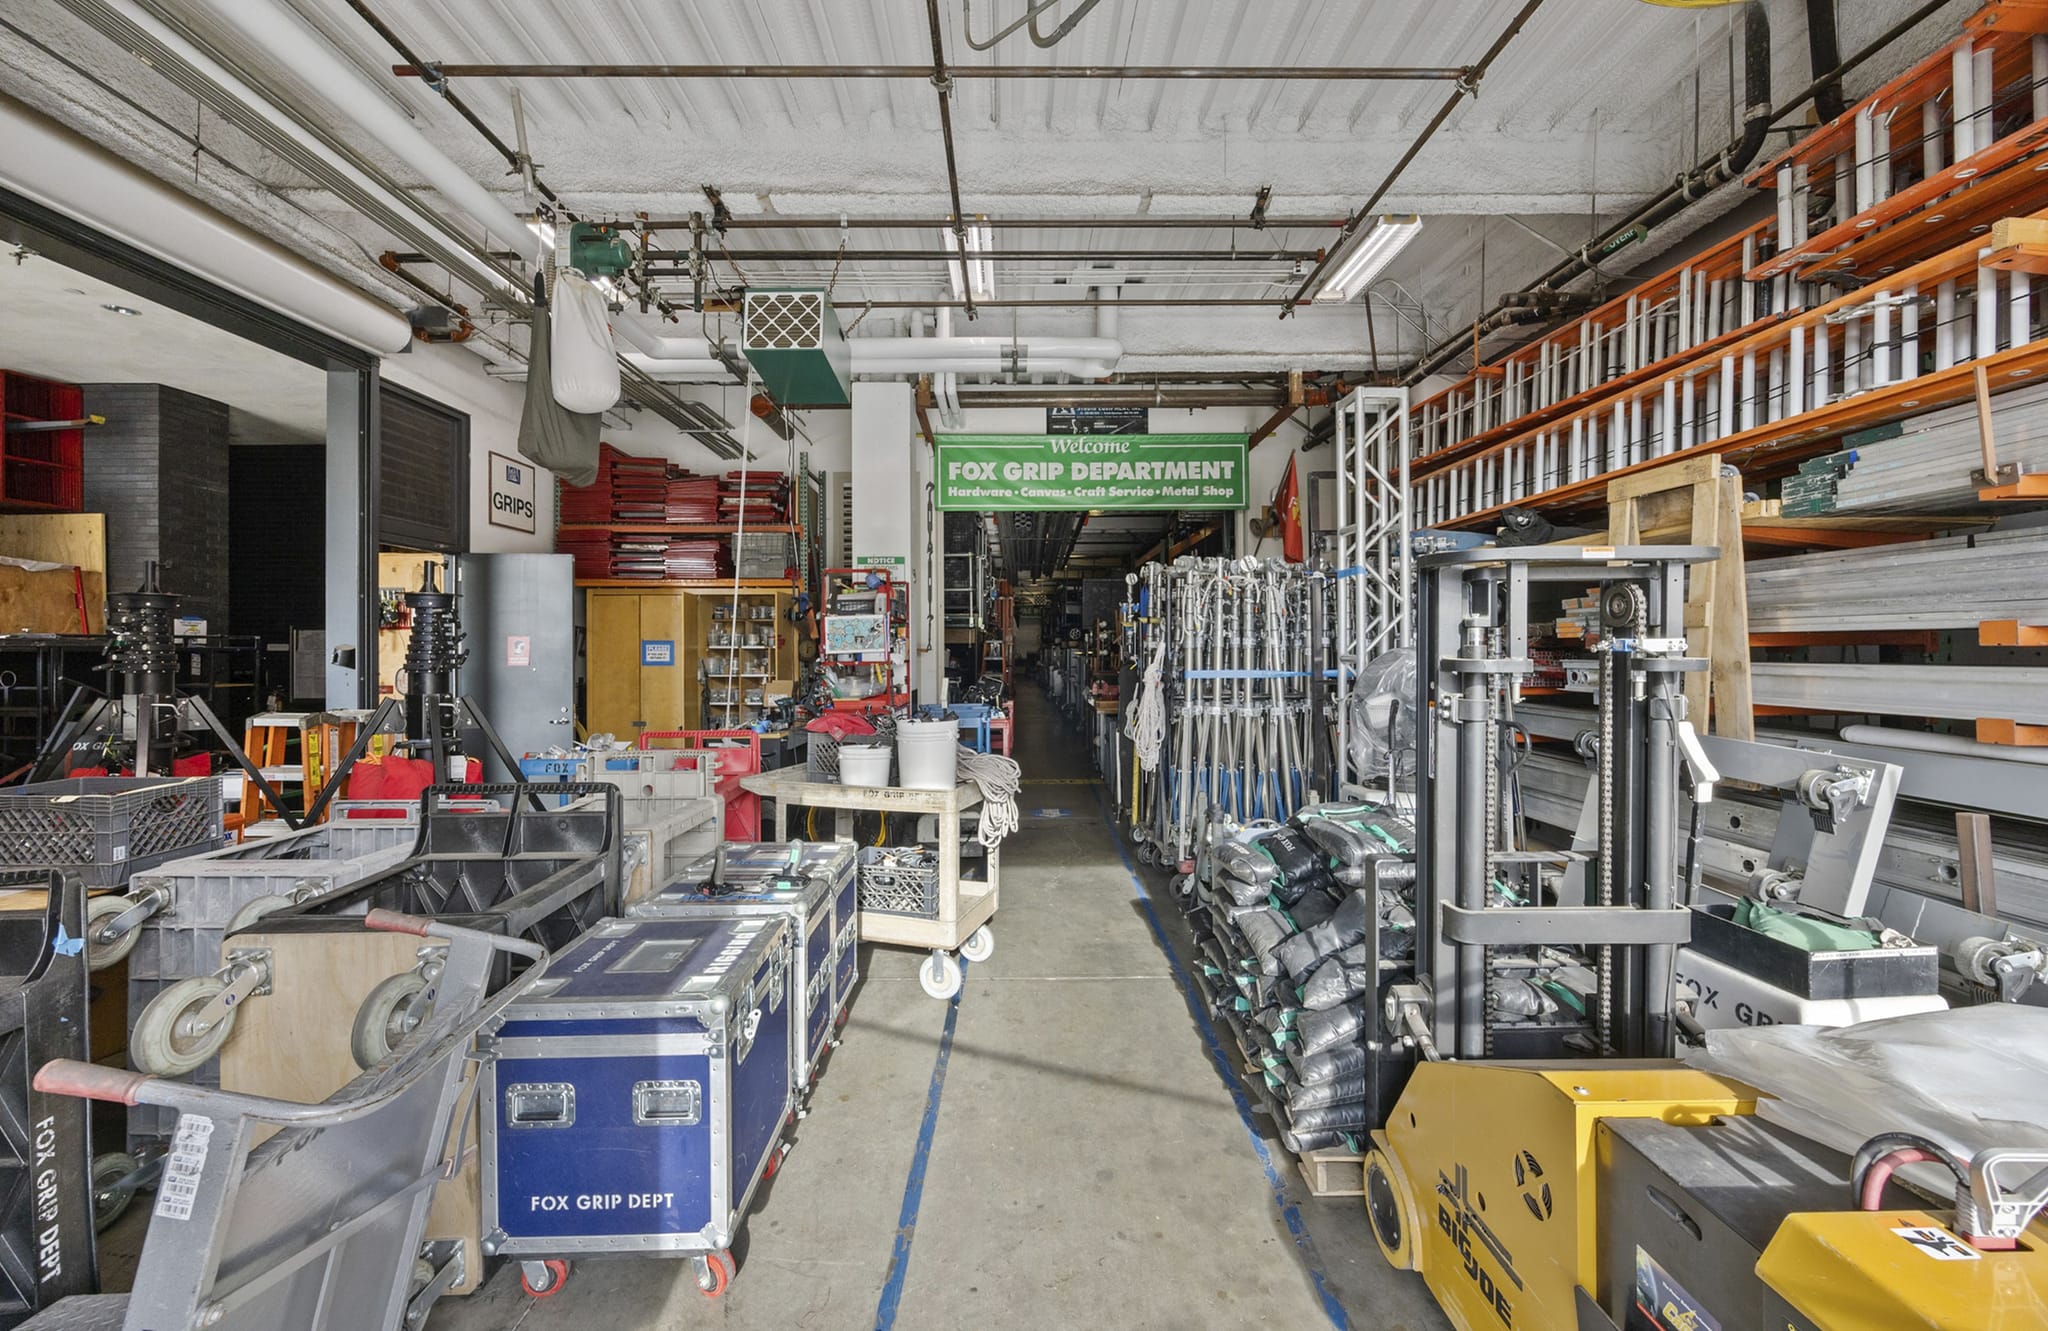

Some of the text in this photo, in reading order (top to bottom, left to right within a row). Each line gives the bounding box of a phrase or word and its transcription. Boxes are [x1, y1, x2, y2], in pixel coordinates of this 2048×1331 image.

[1051, 436, 1131, 454] Welcome
[948, 460, 1235, 481] FOX GRIP DEPARTMENT
[947, 485, 1234, 498] Hardware Canvas Craft Service Metal Shop
[493, 491, 533, 518] GRIPS
[73, 742, 90, 751] OX
[545, 763, 569, 773] FOX
[703, 932, 758, 974] RIGGING
[1735, 1002, 1784, 1026] GR
[36, 1116, 62, 1283] FOX GRIP DEPT
[531, 1193, 674, 1212] FOX GRIP DEPT
[1439, 1202, 1512, 1331] BIG JOE
